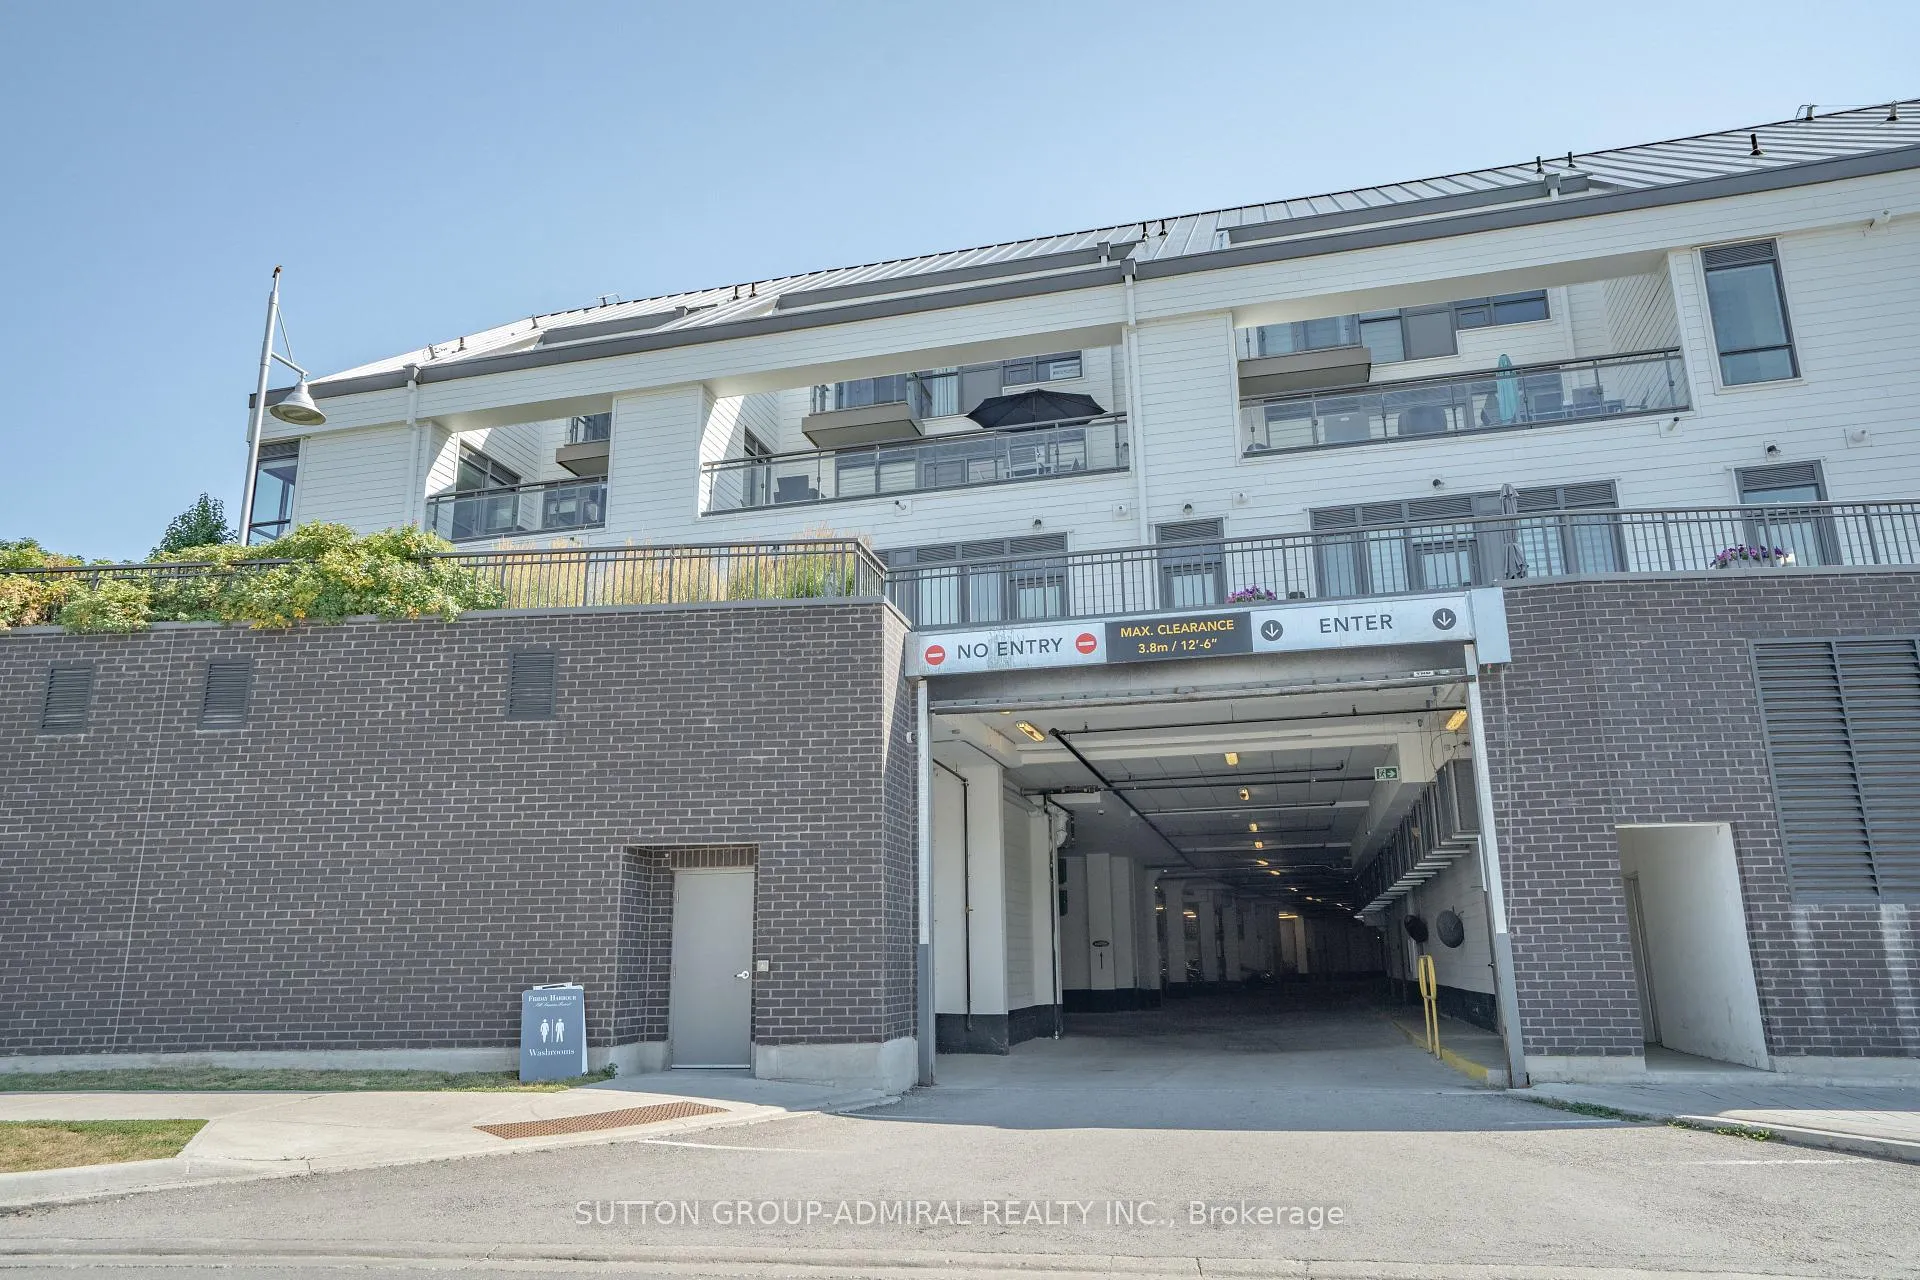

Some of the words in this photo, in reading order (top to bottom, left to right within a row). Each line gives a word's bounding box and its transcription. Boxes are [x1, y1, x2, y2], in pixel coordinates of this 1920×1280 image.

[1120, 626, 1154, 638] MAX.
[1157, 619, 1235, 636] CLEARANCE
[1319, 614, 1393, 634] ENTER
[957, 643, 989, 659] NO
[997, 638, 1063, 657] ENTRY
[1138, 642, 1169, 654] 3.8m
[1171, 640, 1178, 652] /
[528, 1048, 575, 1057] Washrooms
